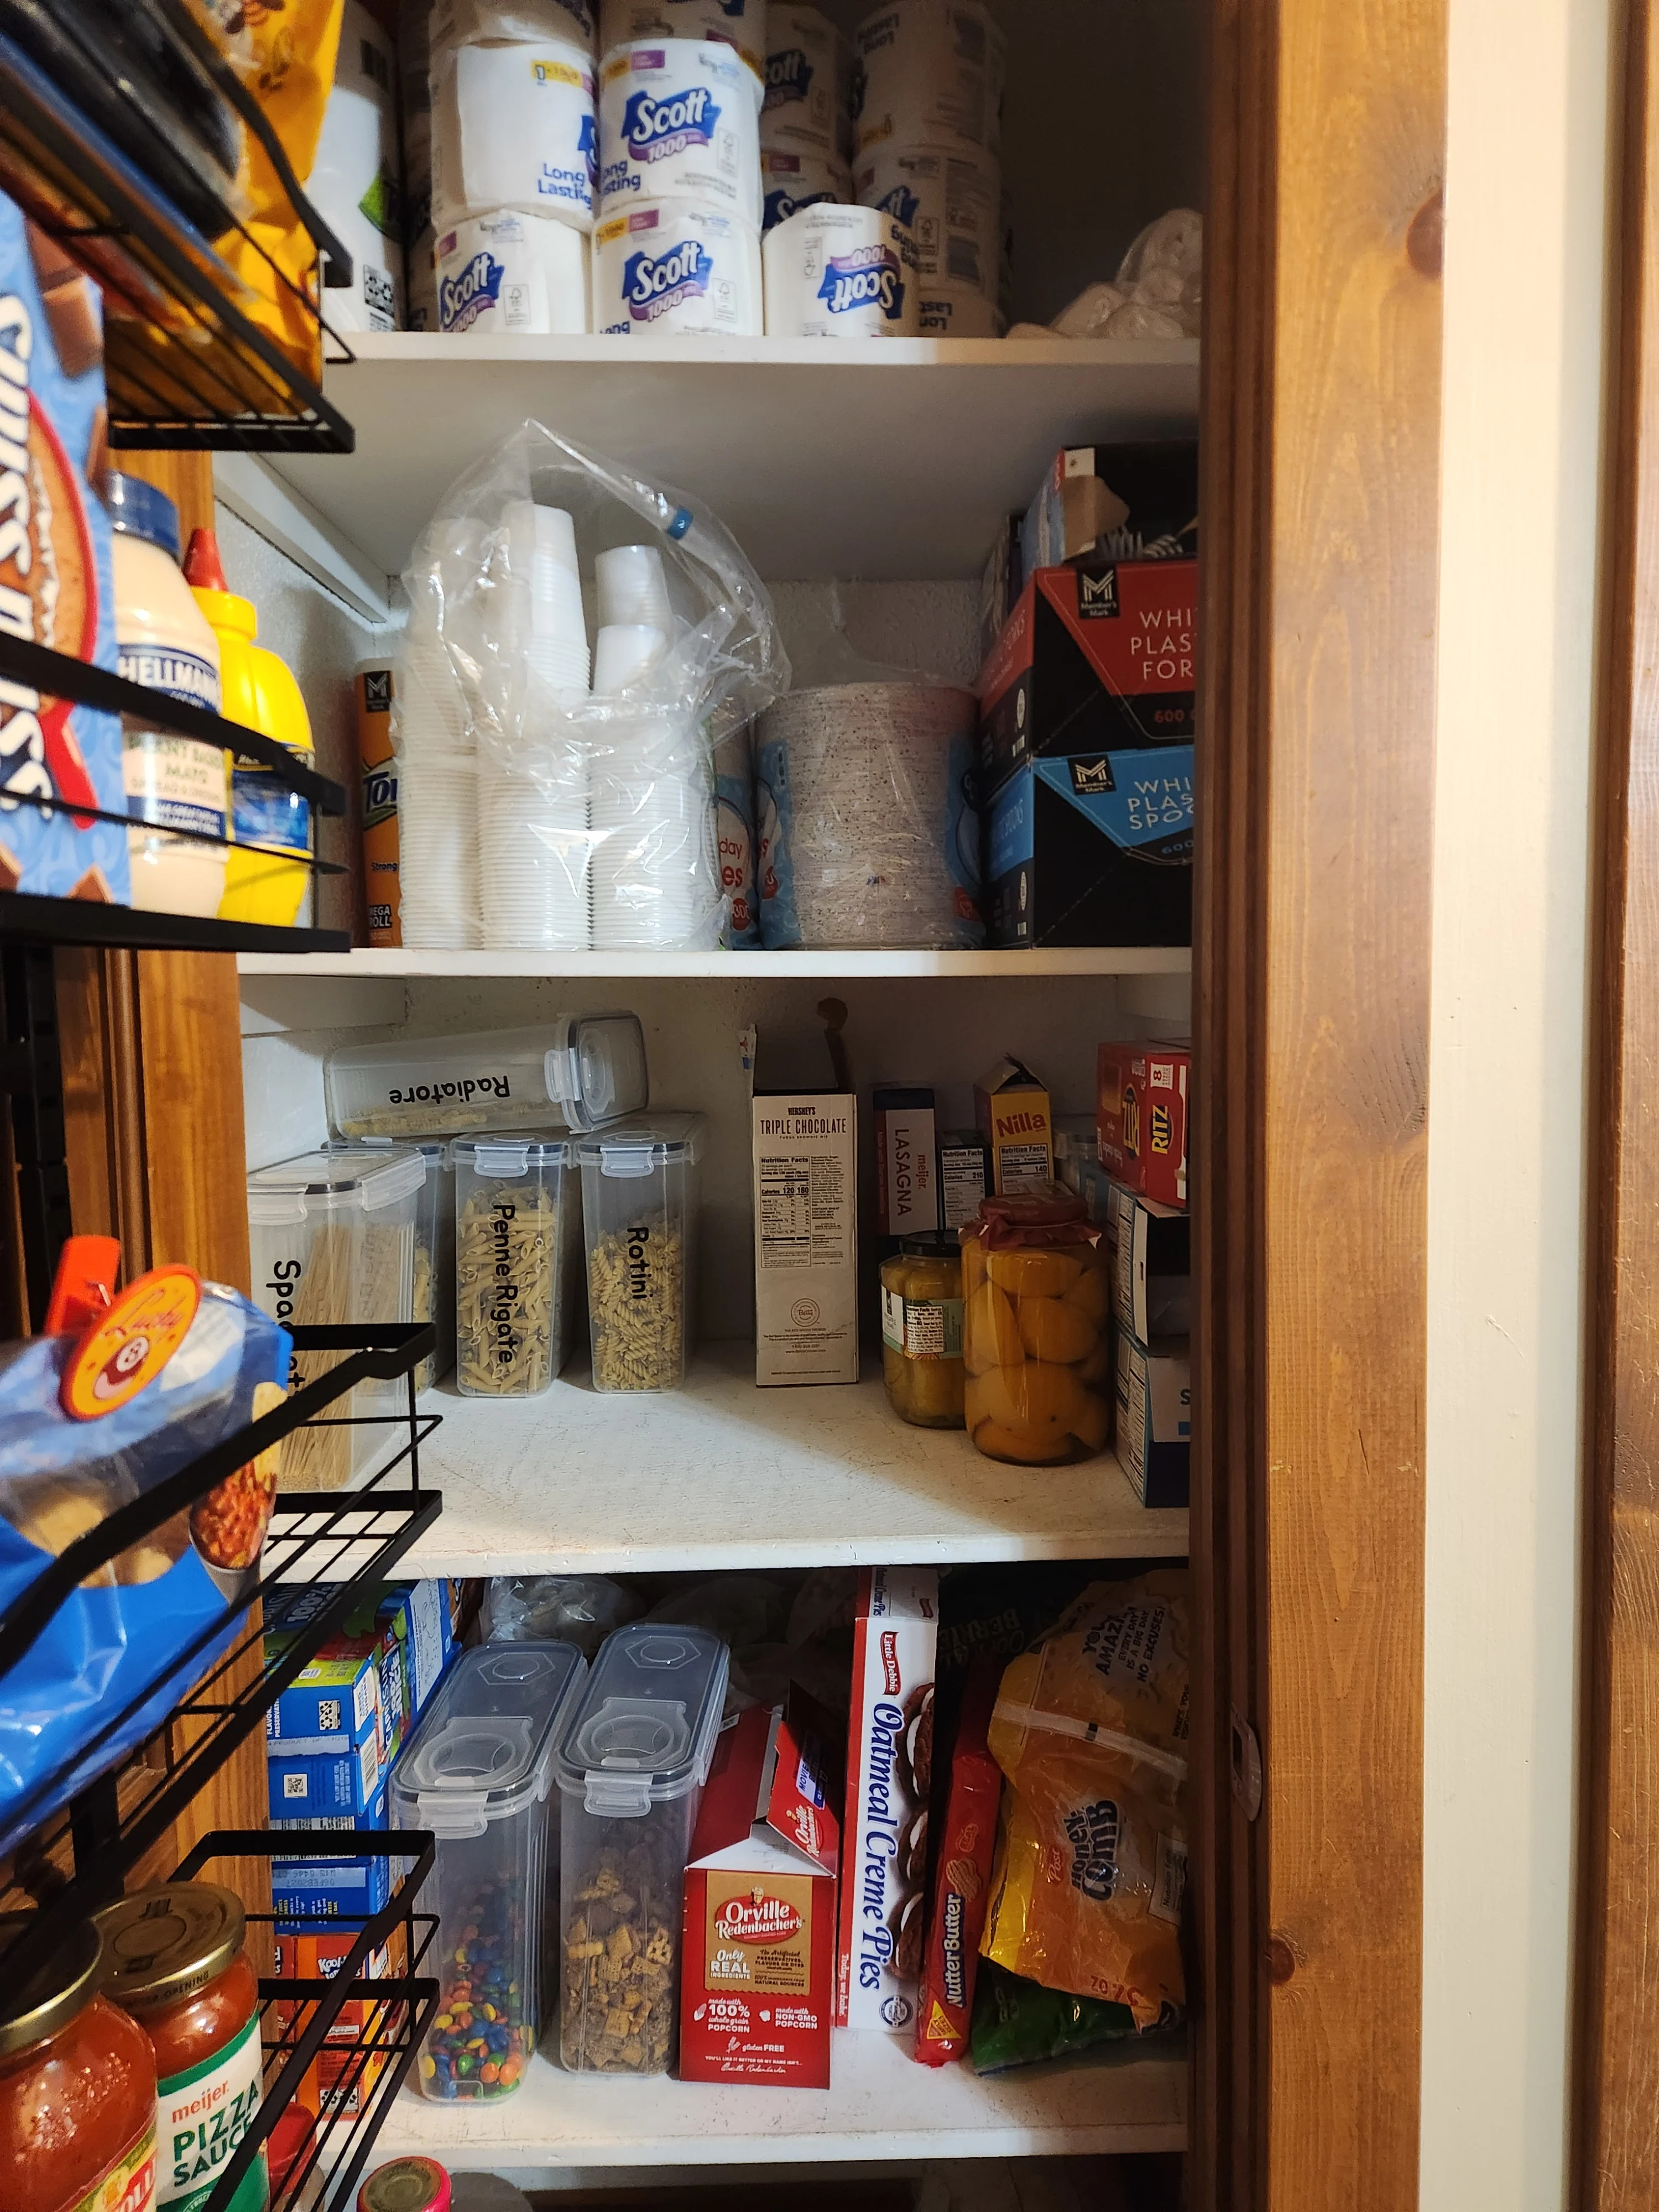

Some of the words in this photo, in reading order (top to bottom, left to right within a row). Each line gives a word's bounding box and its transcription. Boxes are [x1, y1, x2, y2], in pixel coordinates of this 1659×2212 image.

[630, 87, 708, 142] Scott
[646, 136, 688, 164] 1000
[542, 162, 586, 186] Long
[602, 171, 641, 194] sting
[631, 241, 701, 301] Scott
[442, 252, 492, 324] Scott
[832, 270, 898, 311] Scott
[646, 293, 683, 322] 1000
[1140, 608, 1193, 629] WHI
[1131, 633, 1194, 656] PLAS
[389, 1074, 510, 1105] Radiatore
[760, 1119, 791, 1135] TRIPLE
[795, 1118, 847, 1134] CHOCOLATE
[995, 1112, 1047, 1139] Nilla
[1151, 1104, 1168, 1155] RITZ
[894, 1128, 912, 1217] LASAGNA
[493, 1203, 516, 1278] Penne
[626, 1226, 654, 1300] Rotini
[489, 1284, 519, 1365] Rigate
[883, 1633, 893, 1660] Little
[1118, 1632, 1133, 1662] EVERY
[1133, 1630, 1144, 1647] BIG
[885, 1660, 896, 1693] Debbie
[1137, 1663, 1150, 1683] NO
[867, 1702, 905, 1827] Oatmeal
[795, 1804, 809, 1845] Orville
[862, 1830, 898, 1922] Creme
[1048, 1849, 1062, 1883] Post
[725, 1900, 790, 1924] Orville
[944, 1893, 963, 1953] Butter
[714, 1916, 803, 1939] Redenbacher's
[710, 1961, 750, 1974] REAL
[716, 1949, 746, 1962] Only
[859, 1927, 893, 1992] Pies
[710, 1971, 750, 1980] INGREDIENTS
[946, 1953, 964, 2008] Nutter
[708, 2004, 750, 2017] 100%
[730, 2017, 749, 2026] grain
[775, 2020, 817, 2030] POPCORN
[708, 2024, 750, 2033] POPCORN
[742, 2043, 763, 2052] gluten
[763, 2044, 785, 2052] FREE
[173, 2079, 260, 2163] PIZZA
